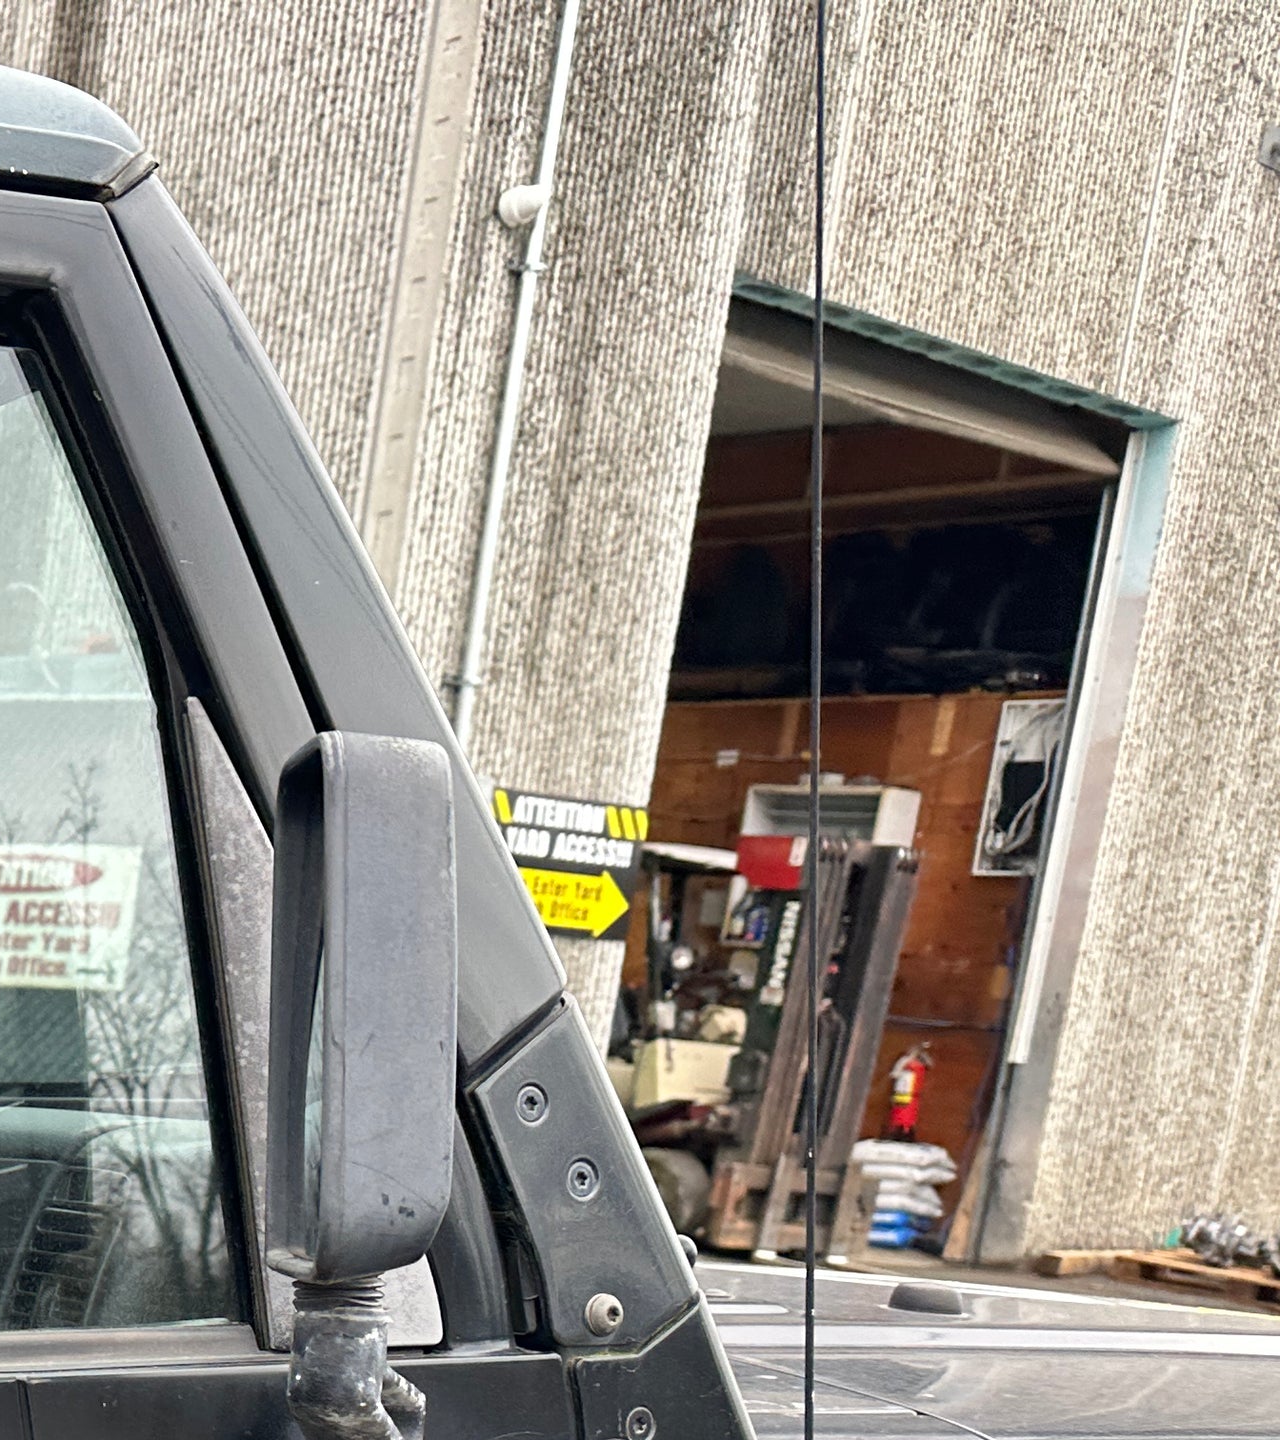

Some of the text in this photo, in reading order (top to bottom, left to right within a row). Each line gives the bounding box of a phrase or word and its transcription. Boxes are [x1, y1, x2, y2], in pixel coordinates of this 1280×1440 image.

[512, 796, 605, 833] ATTENTION
[507, 827, 550, 858] YARD
[575, 881, 603, 902] Yard
[42, 932, 91, 954] Yard
